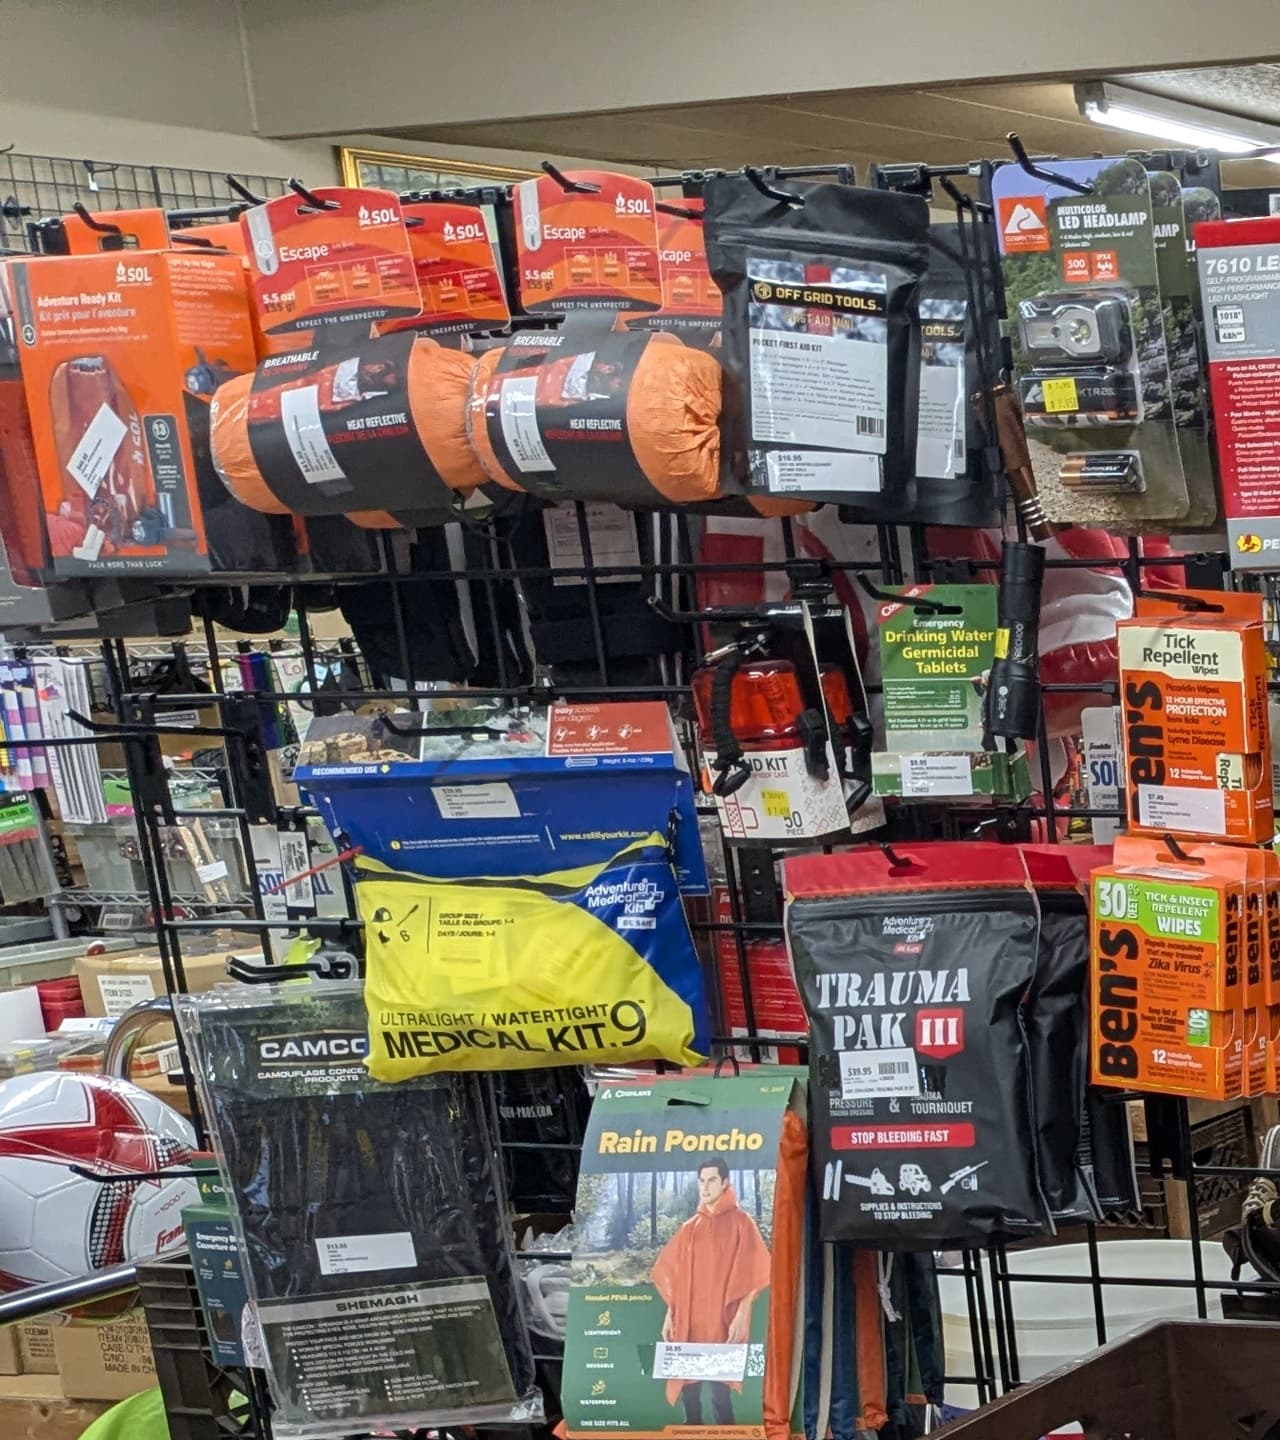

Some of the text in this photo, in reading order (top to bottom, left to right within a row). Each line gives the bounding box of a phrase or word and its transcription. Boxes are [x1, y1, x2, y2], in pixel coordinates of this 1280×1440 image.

[626, 200, 651, 214] SOL
[1057, 204, 1107, 216] MULTICOLOR
[371, 208, 399, 224] SOL
[1059, 212, 1147, 230] LED HEADLAMP
[456, 223, 484, 239] SOL
[543, 225, 586, 240] Escape
[279, 244, 329, 262] Escape
[1067, 258, 1086, 270] 500
[1205, 257, 1252, 275] 7610
[127, 267, 152, 282] SOL
[37, 292, 122, 308] Adventure Ready Kit
[775, 289, 877, 311] OFF GRID TOOLS
[513, 336, 565, 347] BREATHABLE
[264, 351, 320, 368] BREATHABLE
[347, 413, 408, 430] HEAT REFLECTIVE
[569, 419, 622, 430] HEAT REFLECTIVE
[912, 619, 965, 630] Emergency
[885, 629, 994, 645] Drinking Water
[1163, 633, 1196, 650] Tick
[902, 646, 979, 659] Germicidal
[1142, 648, 1219, 667] Repellent
[915, 662, 967, 674] Tablets
[1191, 665, 1220, 676] Wipes
[1165, 704, 1228, 717] PROTECTION
[766, 757, 788, 771] KIT
[585, 879, 645, 898] Adventure
[587, 892, 637, 909] Medical
[624, 903, 645, 914] Kits
[1151, 903, 1209, 918] REPELLENT
[1157, 915, 1202, 936] WIPES
[1148, 957, 1201, 975] Zika Virus
[815, 968, 971, 1009] TRAUMA
[1100, 924, 1139, 1079] Ben's
[380, 1004, 610, 1027] ULTRALIGHT WATERTIGHT
[832, 1012, 960, 1052] PAK III
[257, 1067, 327, 1079] CAMOUFLAGE
[304, 1075, 359, 1084] PRODUCTS
[847, 1066, 873, 1077] $39.95
[599, 1128, 764, 1155] Rain Poncho
[850, 1128, 950, 1144] STOP BLEEDING FAST
[335, 1293, 420, 1313] SHEMAGH
